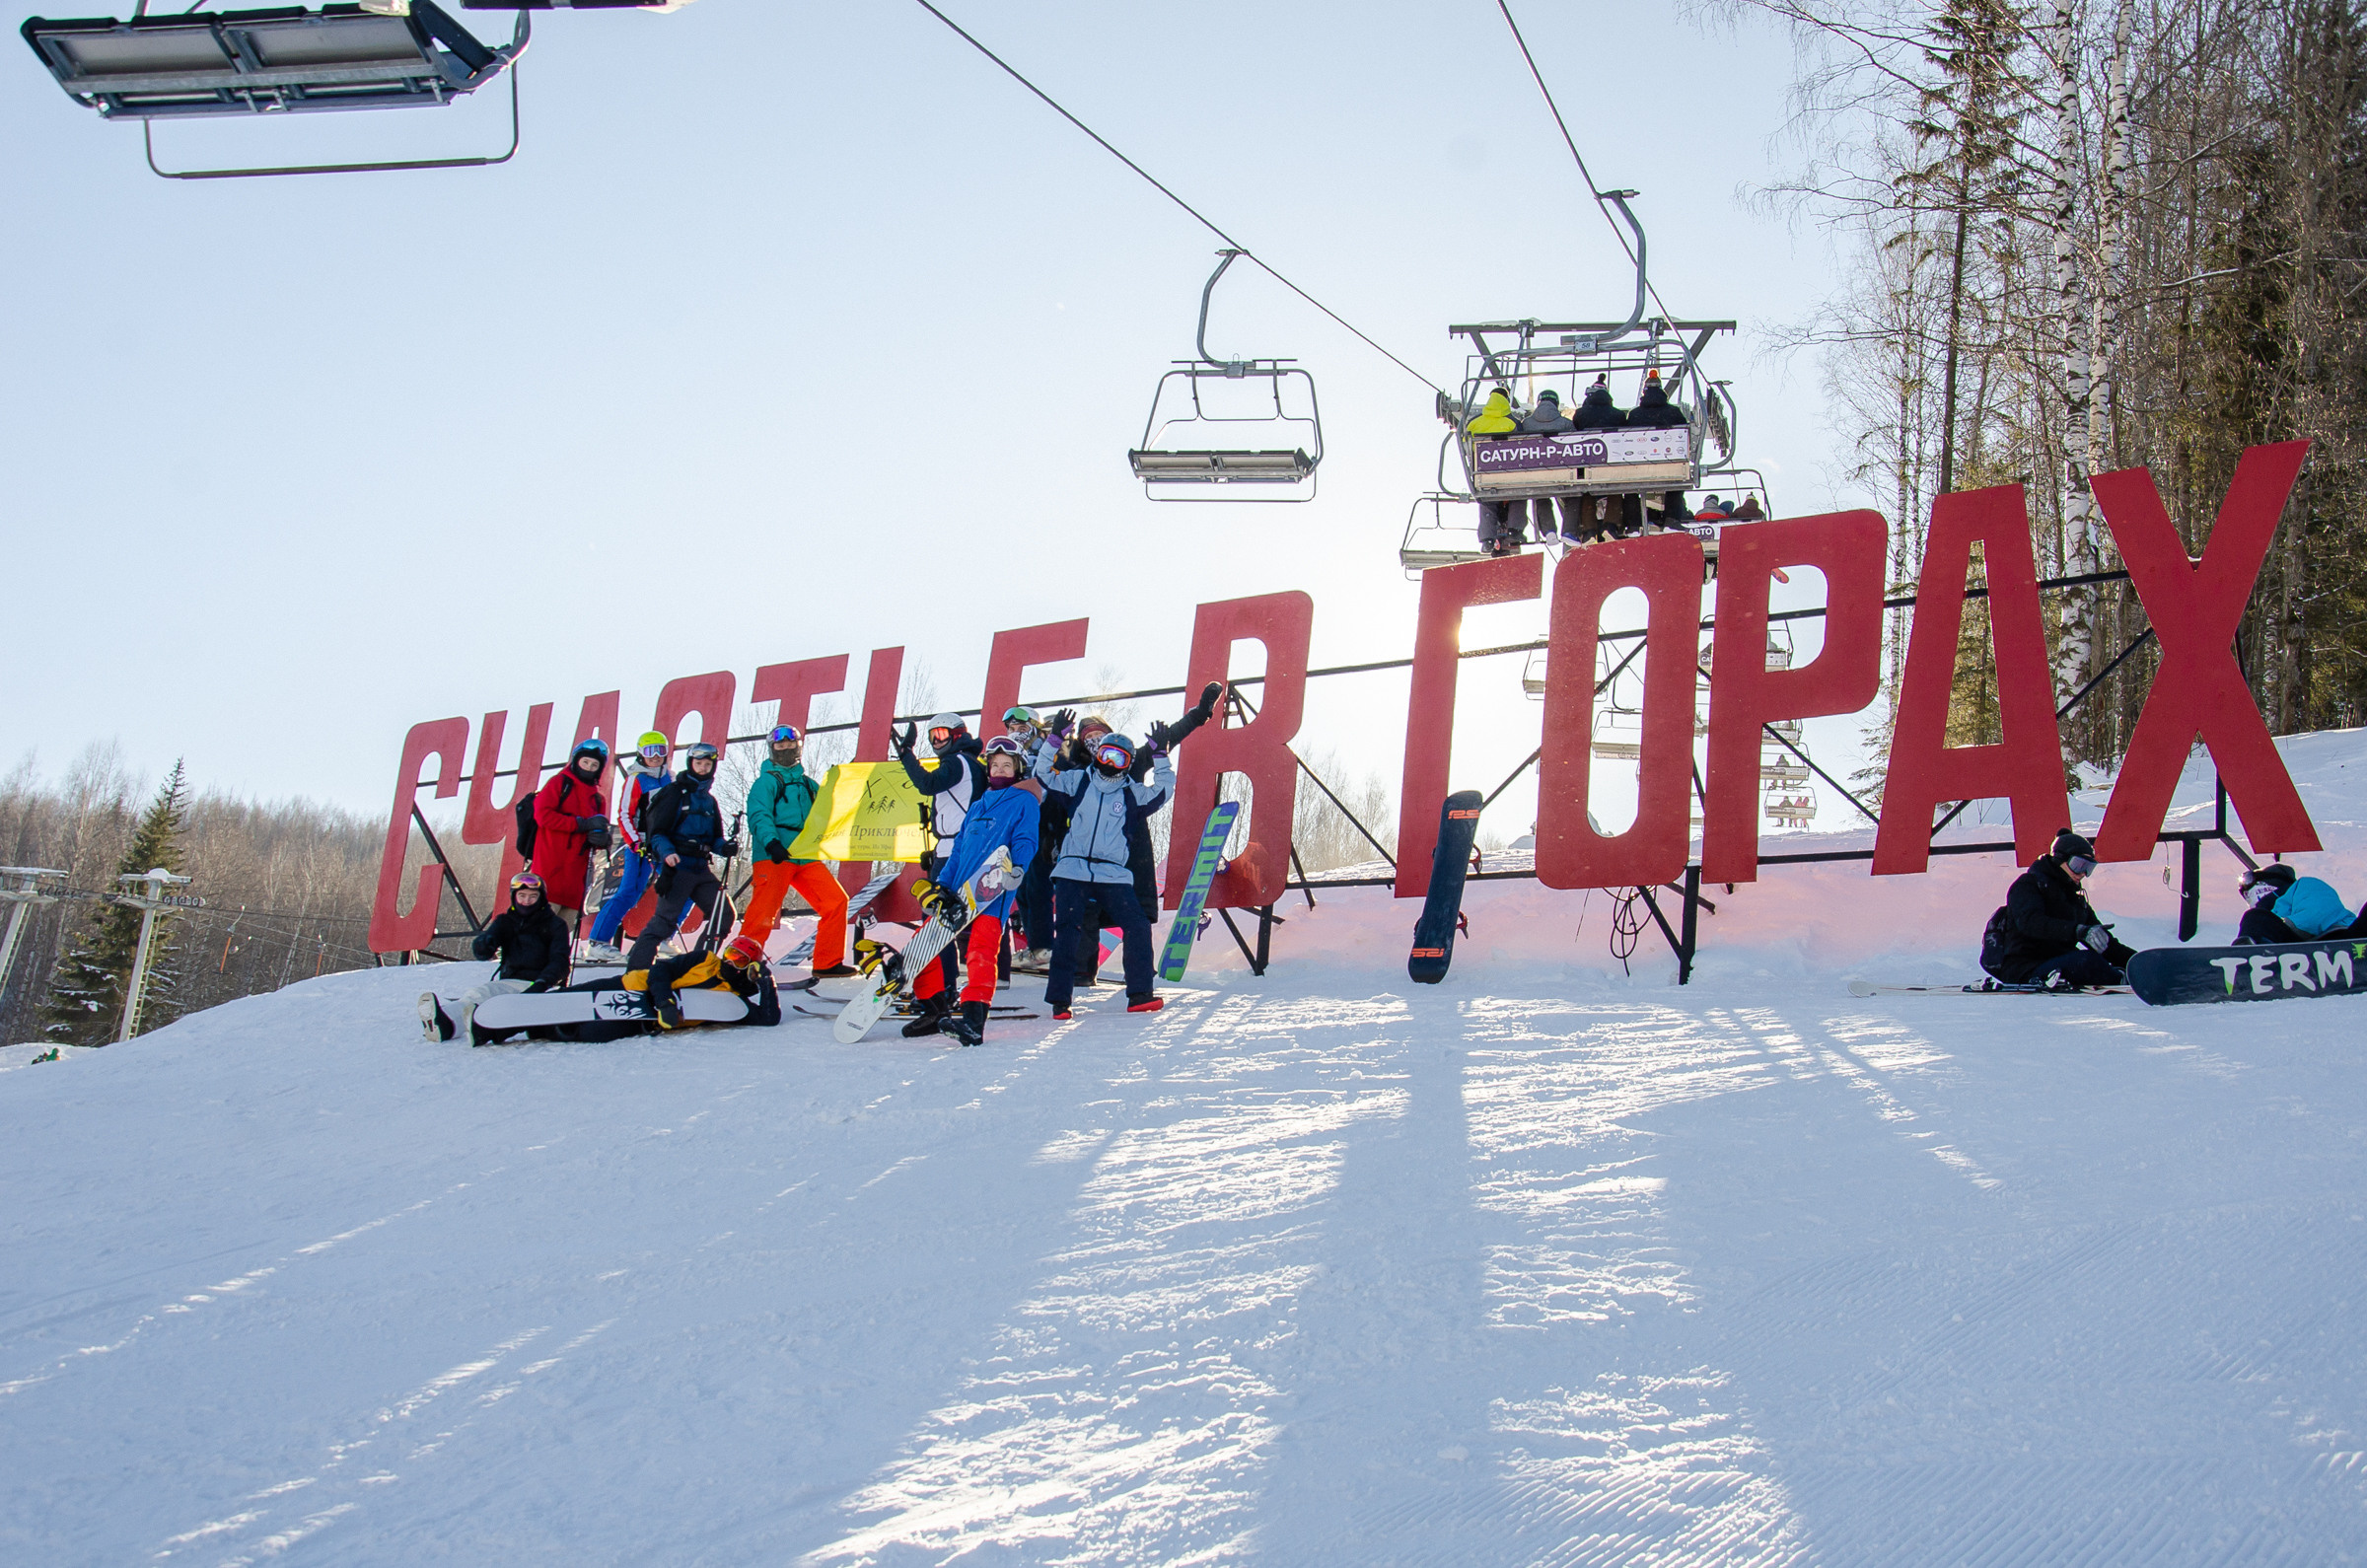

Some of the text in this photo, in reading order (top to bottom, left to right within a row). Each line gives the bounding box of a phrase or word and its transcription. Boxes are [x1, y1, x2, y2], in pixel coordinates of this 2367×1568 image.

[1479, 443, 1604, 463] САТУРН-Р-АВТО
[1164, 590, 1314, 909] В
[1394, 439, 2324, 897] ГОРАХ
[1160, 807, 1233, 978] TERMIT
[2209, 950, 2354, 996] TERM
